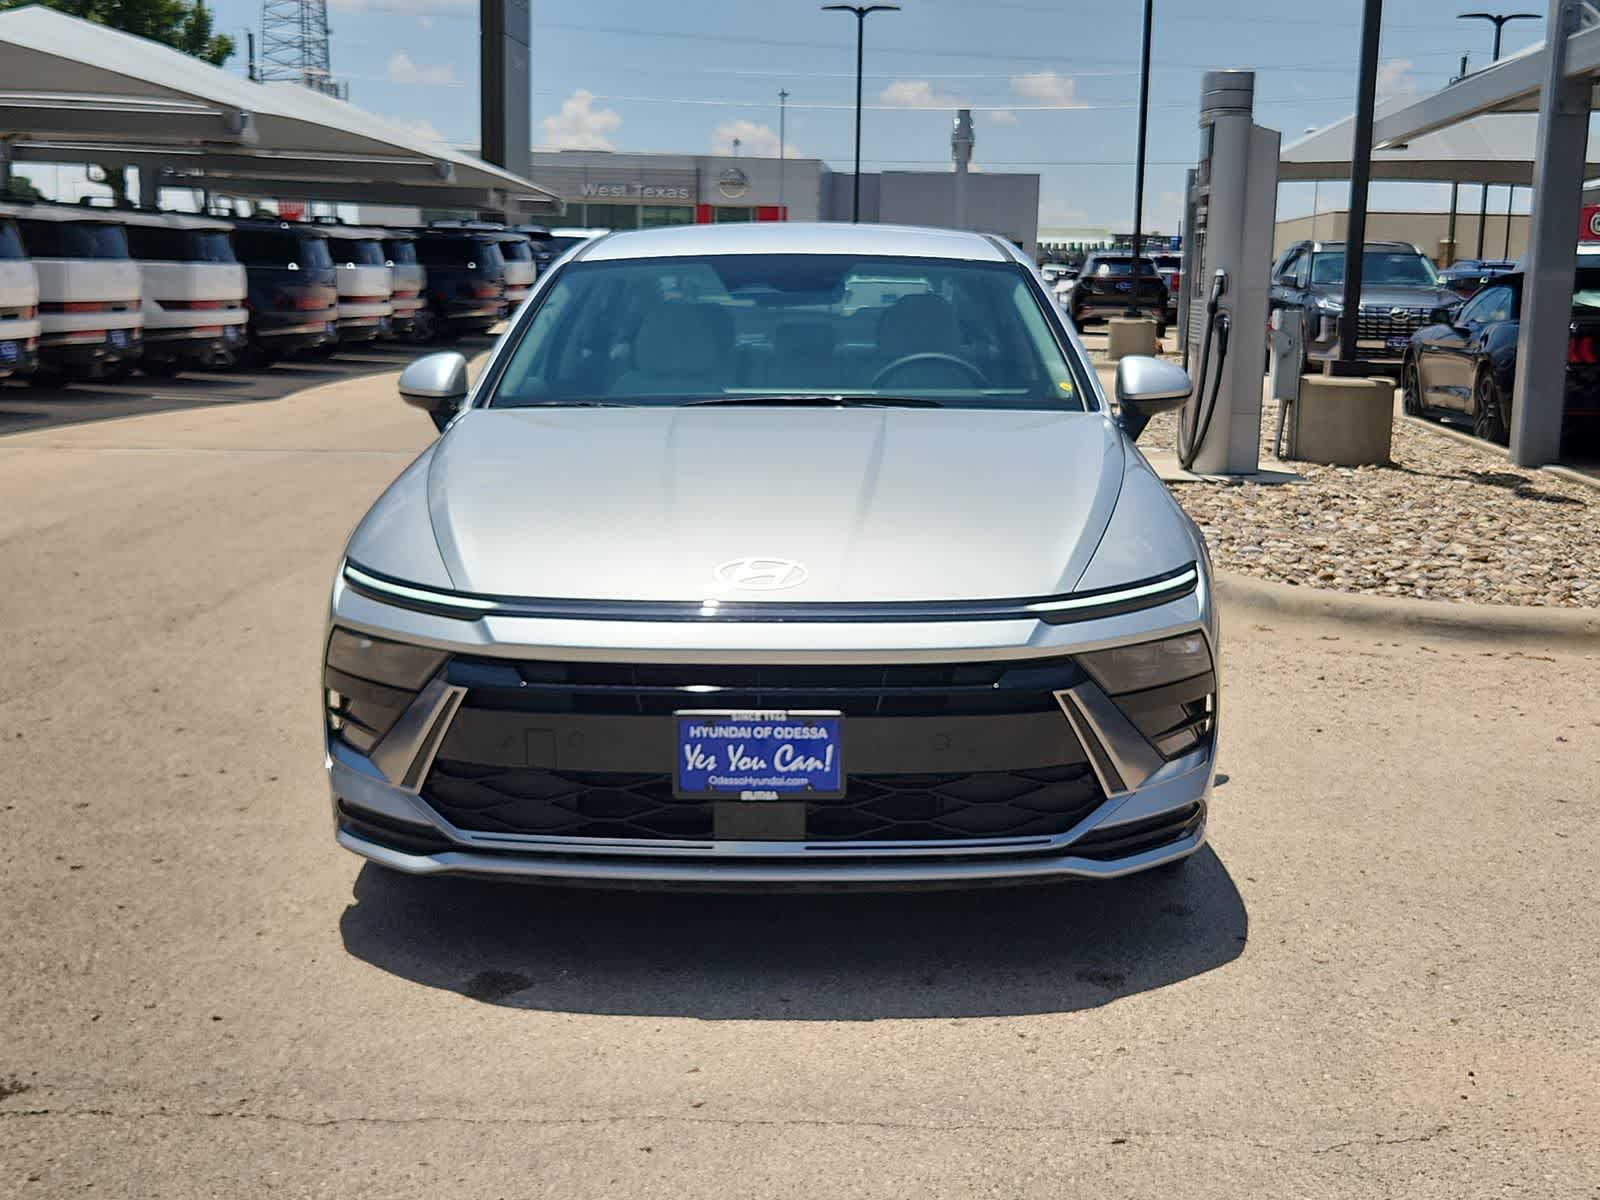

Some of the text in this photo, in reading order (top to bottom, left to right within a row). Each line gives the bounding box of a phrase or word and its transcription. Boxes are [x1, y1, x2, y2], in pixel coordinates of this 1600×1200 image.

[580, 184, 689, 199] West Texas
[689, 726, 828, 739] HYUNDAI OF ODESSA
[684, 743, 834, 772] Yes You Can!
[708, 775, 808, 787] OdessaHyundai.com
